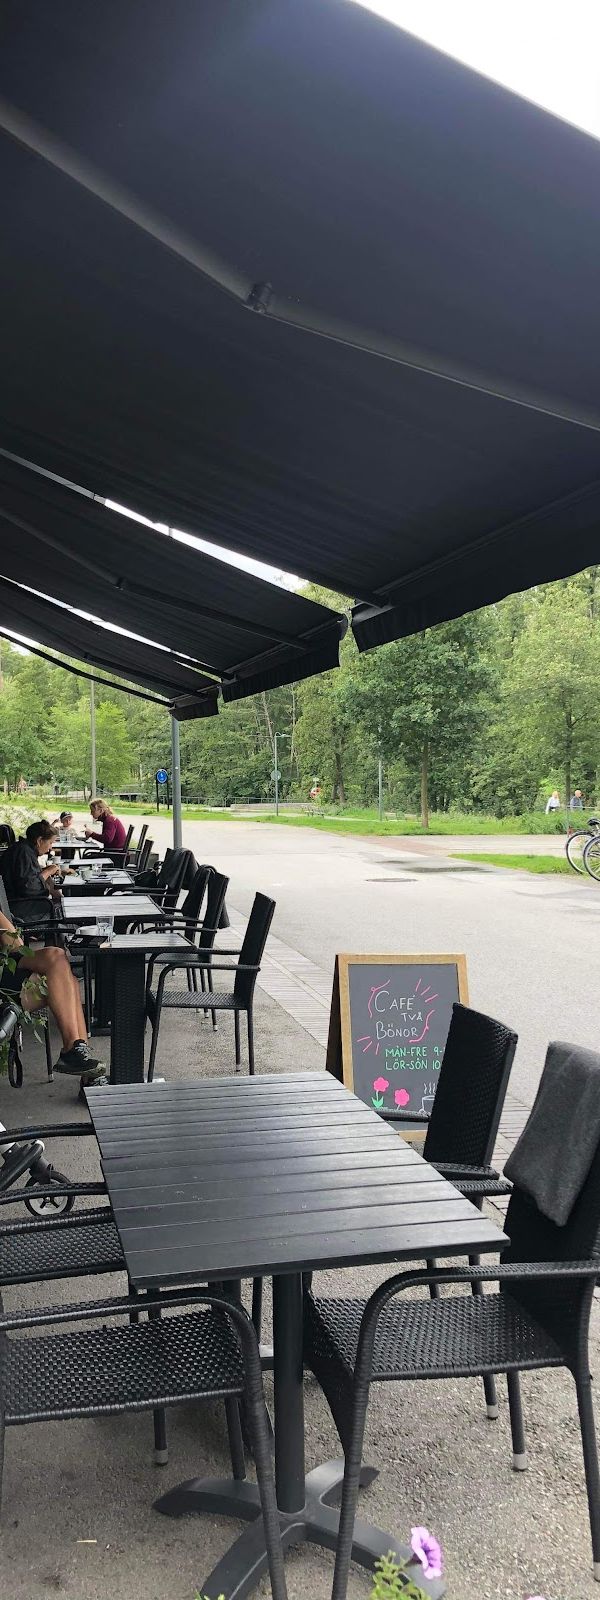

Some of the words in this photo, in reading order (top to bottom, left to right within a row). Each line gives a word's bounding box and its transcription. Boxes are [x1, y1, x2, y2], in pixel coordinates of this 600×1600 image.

[374, 990, 415, 1013] CAFÉ
[401, 1011, 423, 1022] TVÅ
[375, 1020, 418, 1040] BÖNOR
[385, 1045, 428, 1058] MÅN-FRE
